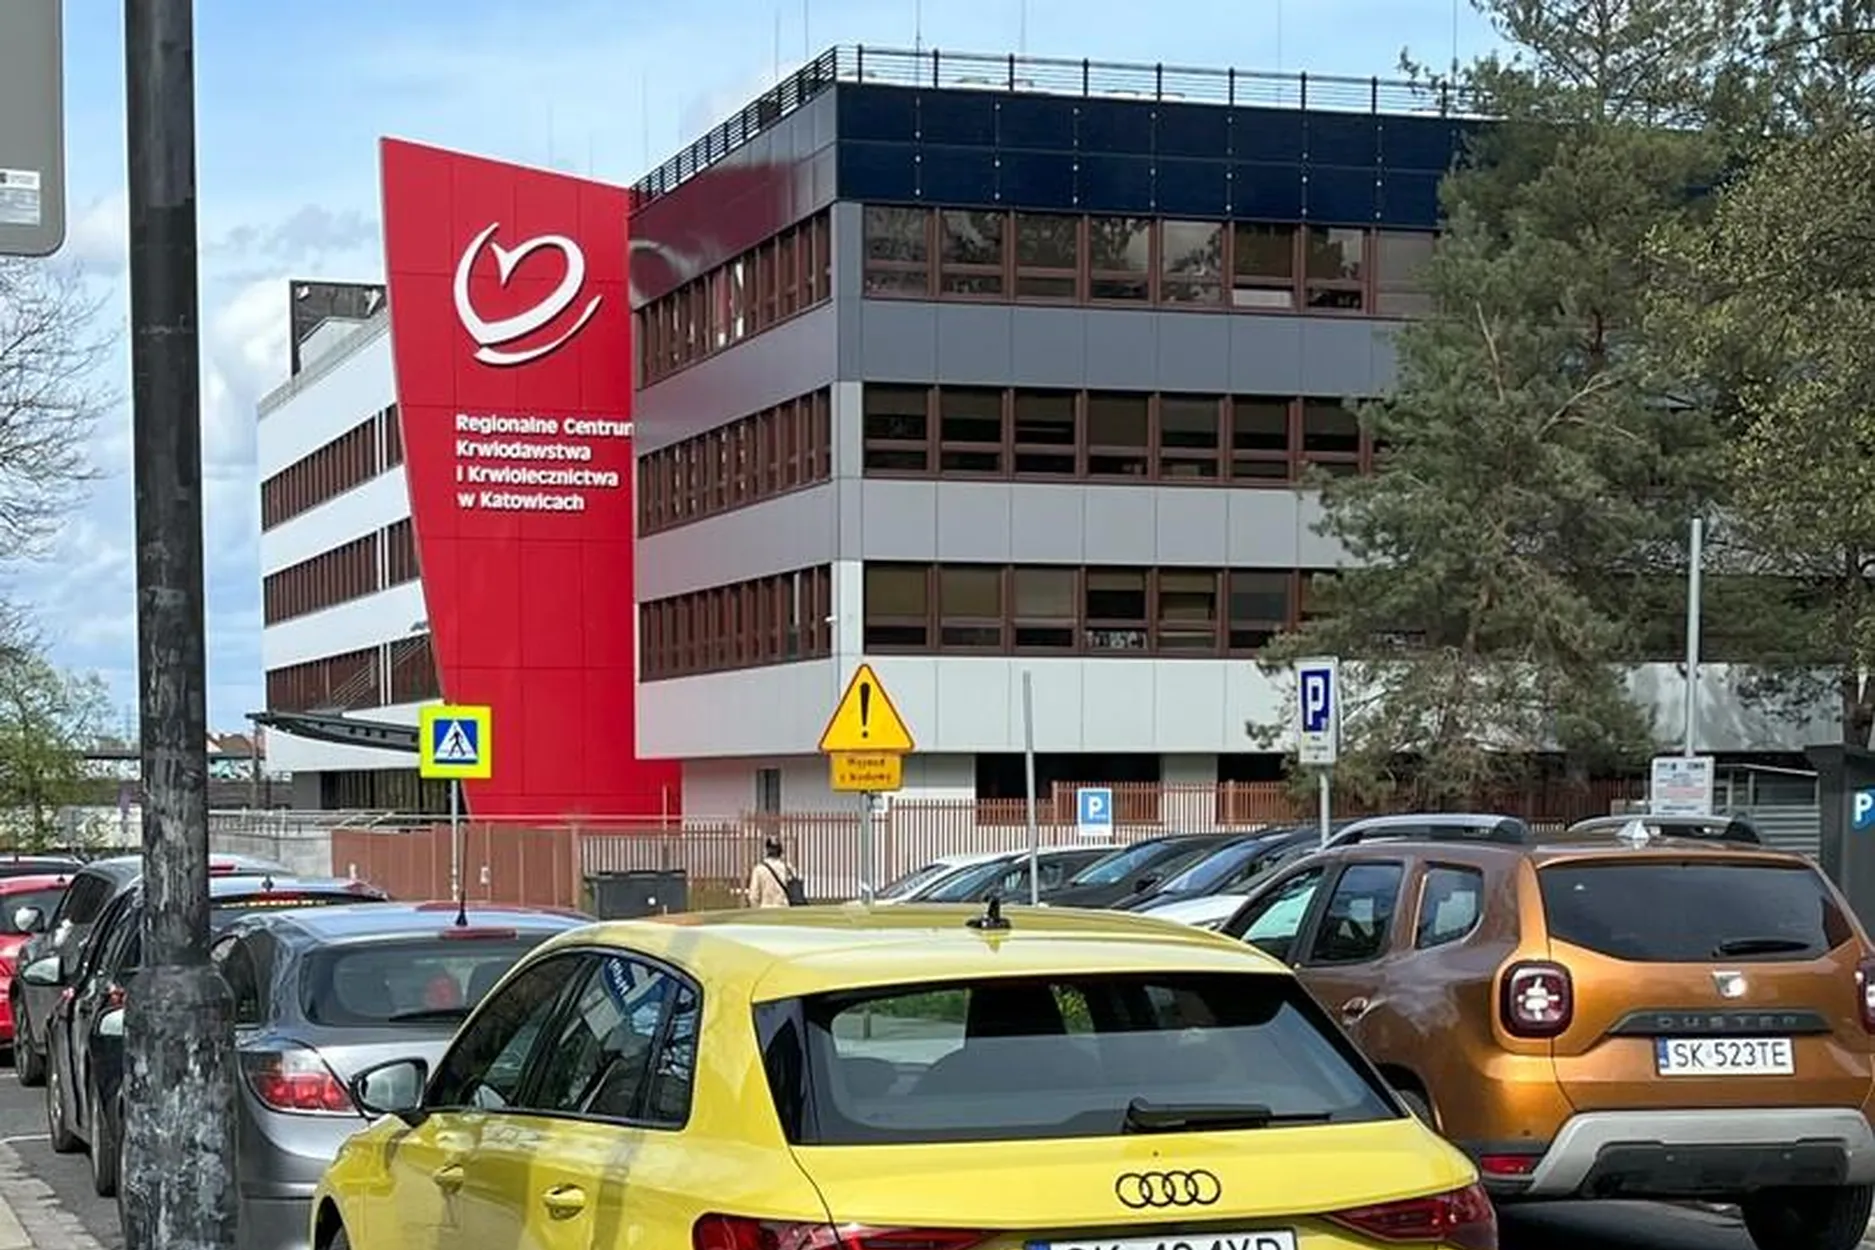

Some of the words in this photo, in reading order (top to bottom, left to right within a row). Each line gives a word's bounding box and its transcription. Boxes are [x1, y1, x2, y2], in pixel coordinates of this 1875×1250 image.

[456, 414, 558, 435] Regionalne
[456, 440, 591, 460] Krwiodawstwa
[468, 465, 618, 486] Krwiolecznictwa
[457, 493, 476, 508] w
[480, 491, 584, 510] Katowicach
[1307, 676, 1325, 725] P
[1088, 796, 1104, 820] P
[1855, 792, 1873, 822] P
[1673, 1042, 1705, 1068] SK
[1714, 1042, 1788, 1068] 523TE
